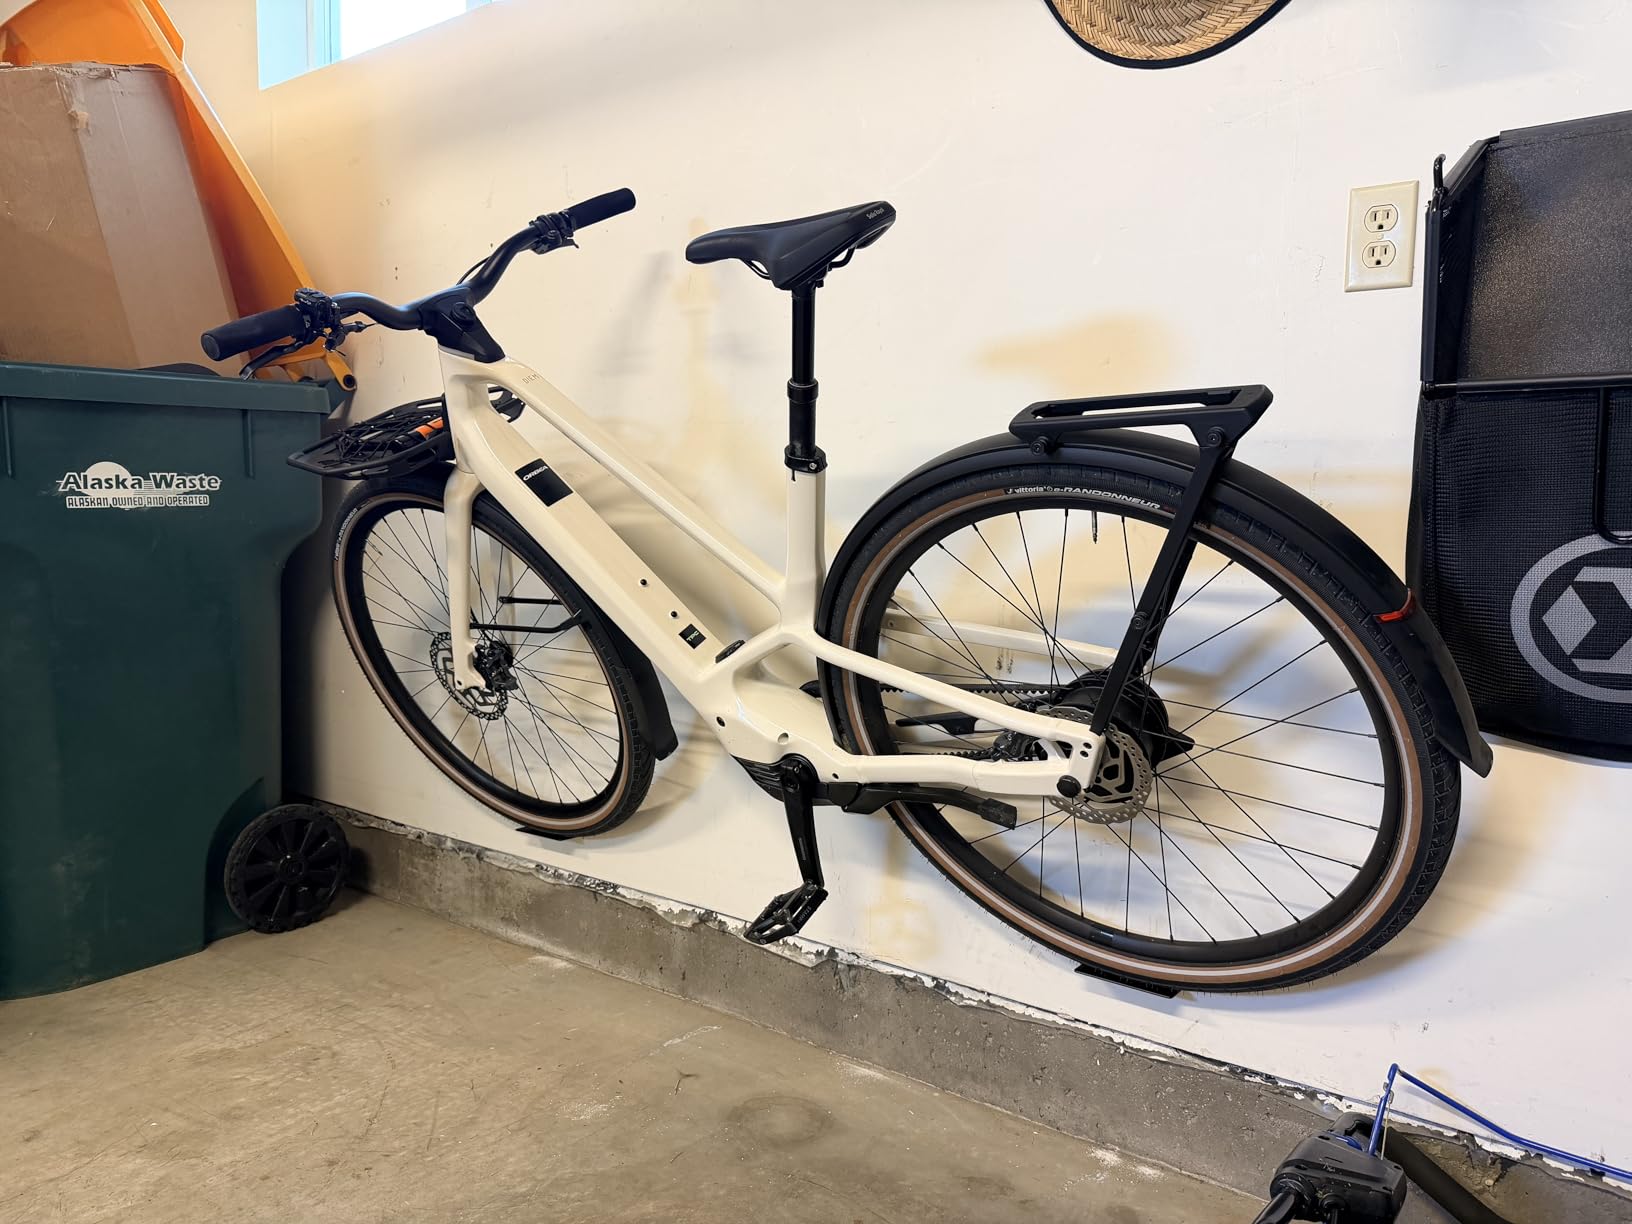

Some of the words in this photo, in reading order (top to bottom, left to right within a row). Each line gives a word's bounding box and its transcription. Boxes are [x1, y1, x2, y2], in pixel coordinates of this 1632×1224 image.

[523, 465, 549, 481] ORBEA
[59, 473, 144, 491] Alaska
[150, 473, 221, 491] Waste
[67, 496, 110, 507] ALASKAN
[112, 496, 144, 506] OWNED
[146, 496, 164, 505] AND
[167, 495, 208, 505] OPERATED
